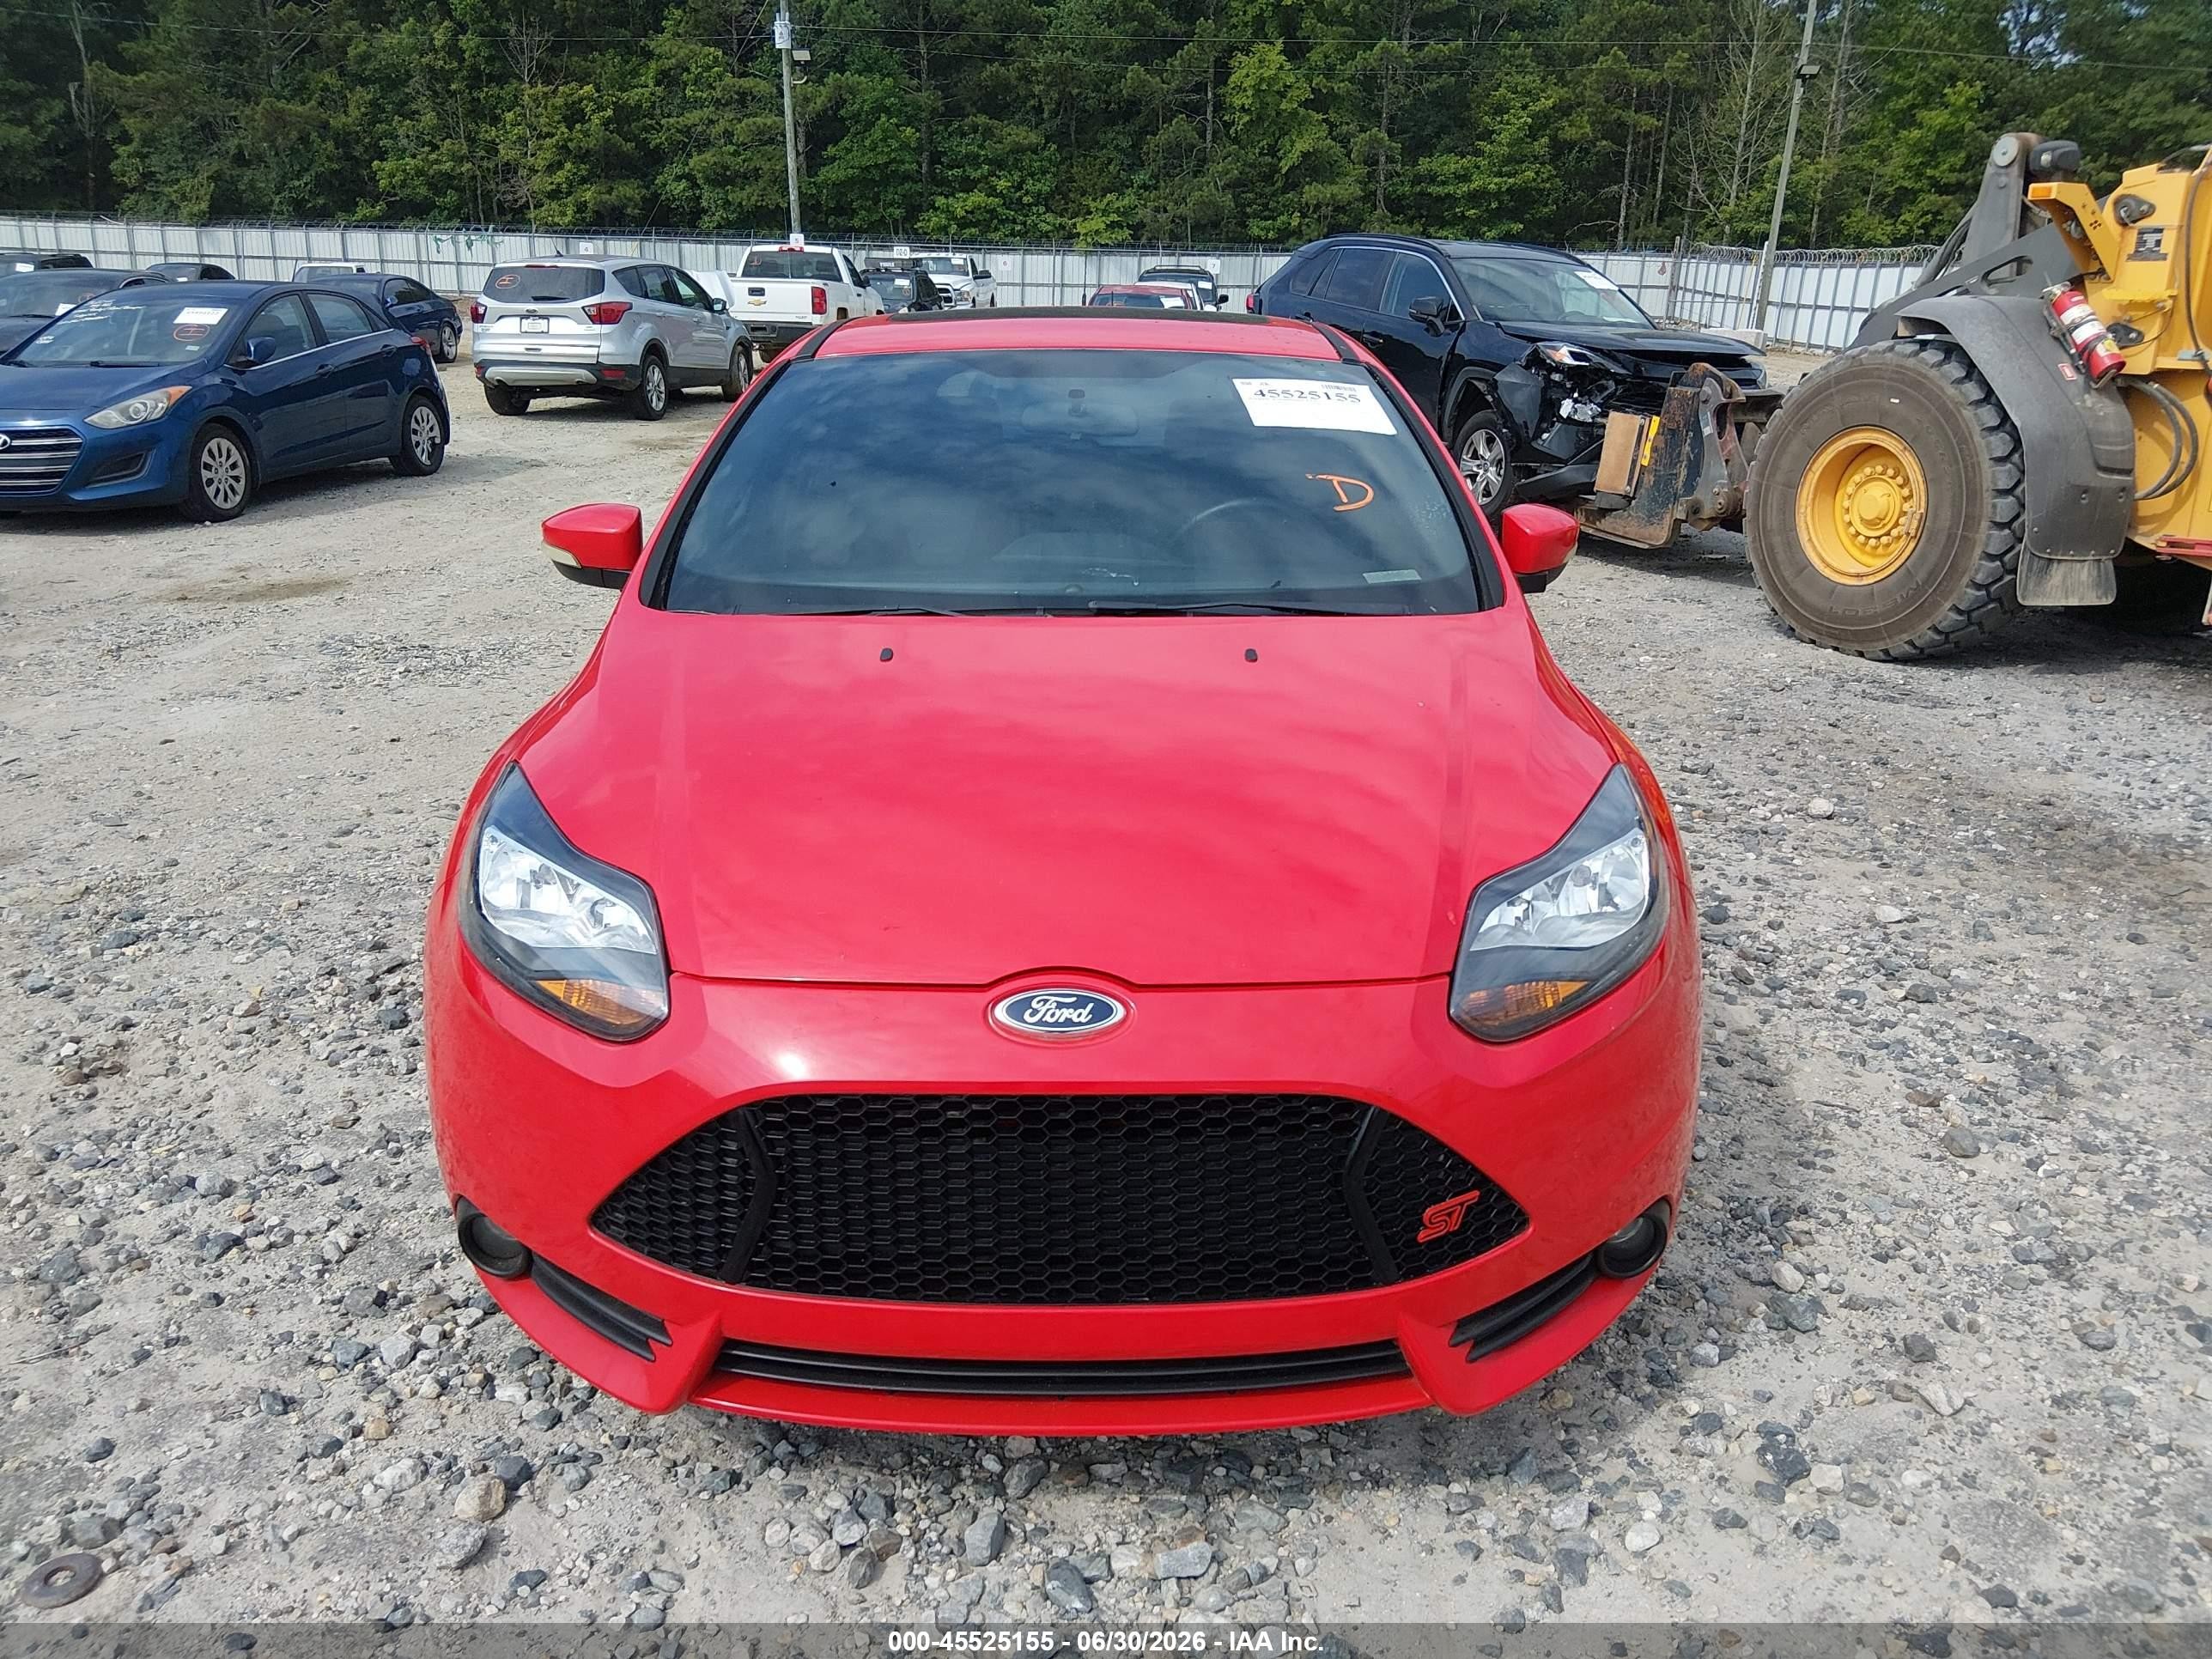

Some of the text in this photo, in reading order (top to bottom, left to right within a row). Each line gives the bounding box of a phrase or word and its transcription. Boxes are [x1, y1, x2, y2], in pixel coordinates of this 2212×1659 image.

[1254, 389, 1361, 403] 45525155
[1305, 473, 1375, 513] D
[1023, 995, 1094, 1024] Ford
[1417, 1189, 1480, 1243] ST
